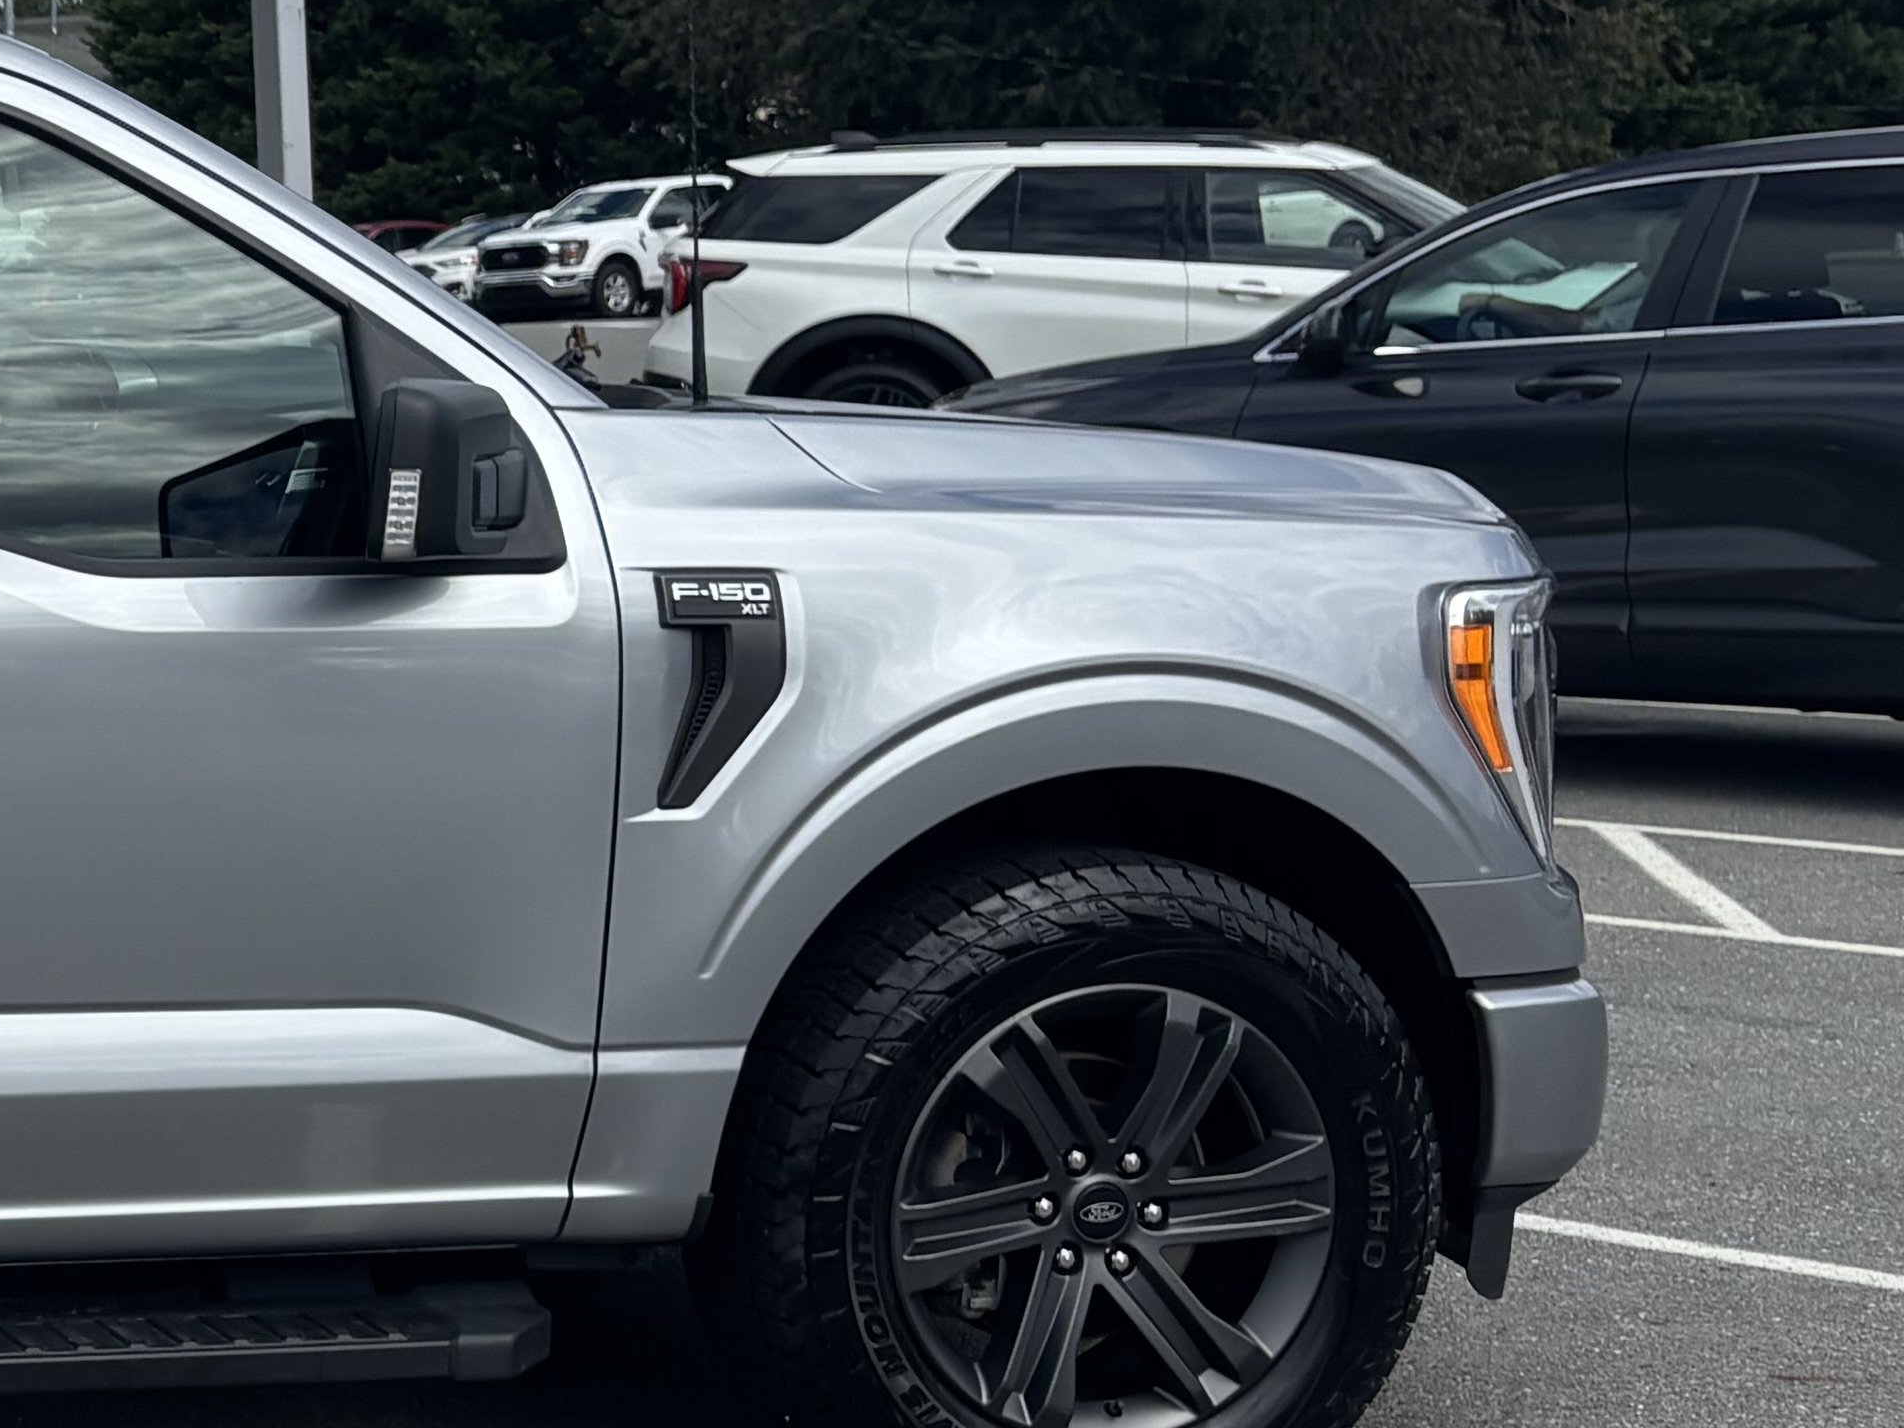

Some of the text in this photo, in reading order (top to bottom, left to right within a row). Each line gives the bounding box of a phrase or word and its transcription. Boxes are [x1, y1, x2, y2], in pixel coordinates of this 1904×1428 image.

[671, 582, 771, 601] F-150
[741, 602, 769, 615] XLT
[1351, 1092, 1392, 1269] KUMHO
